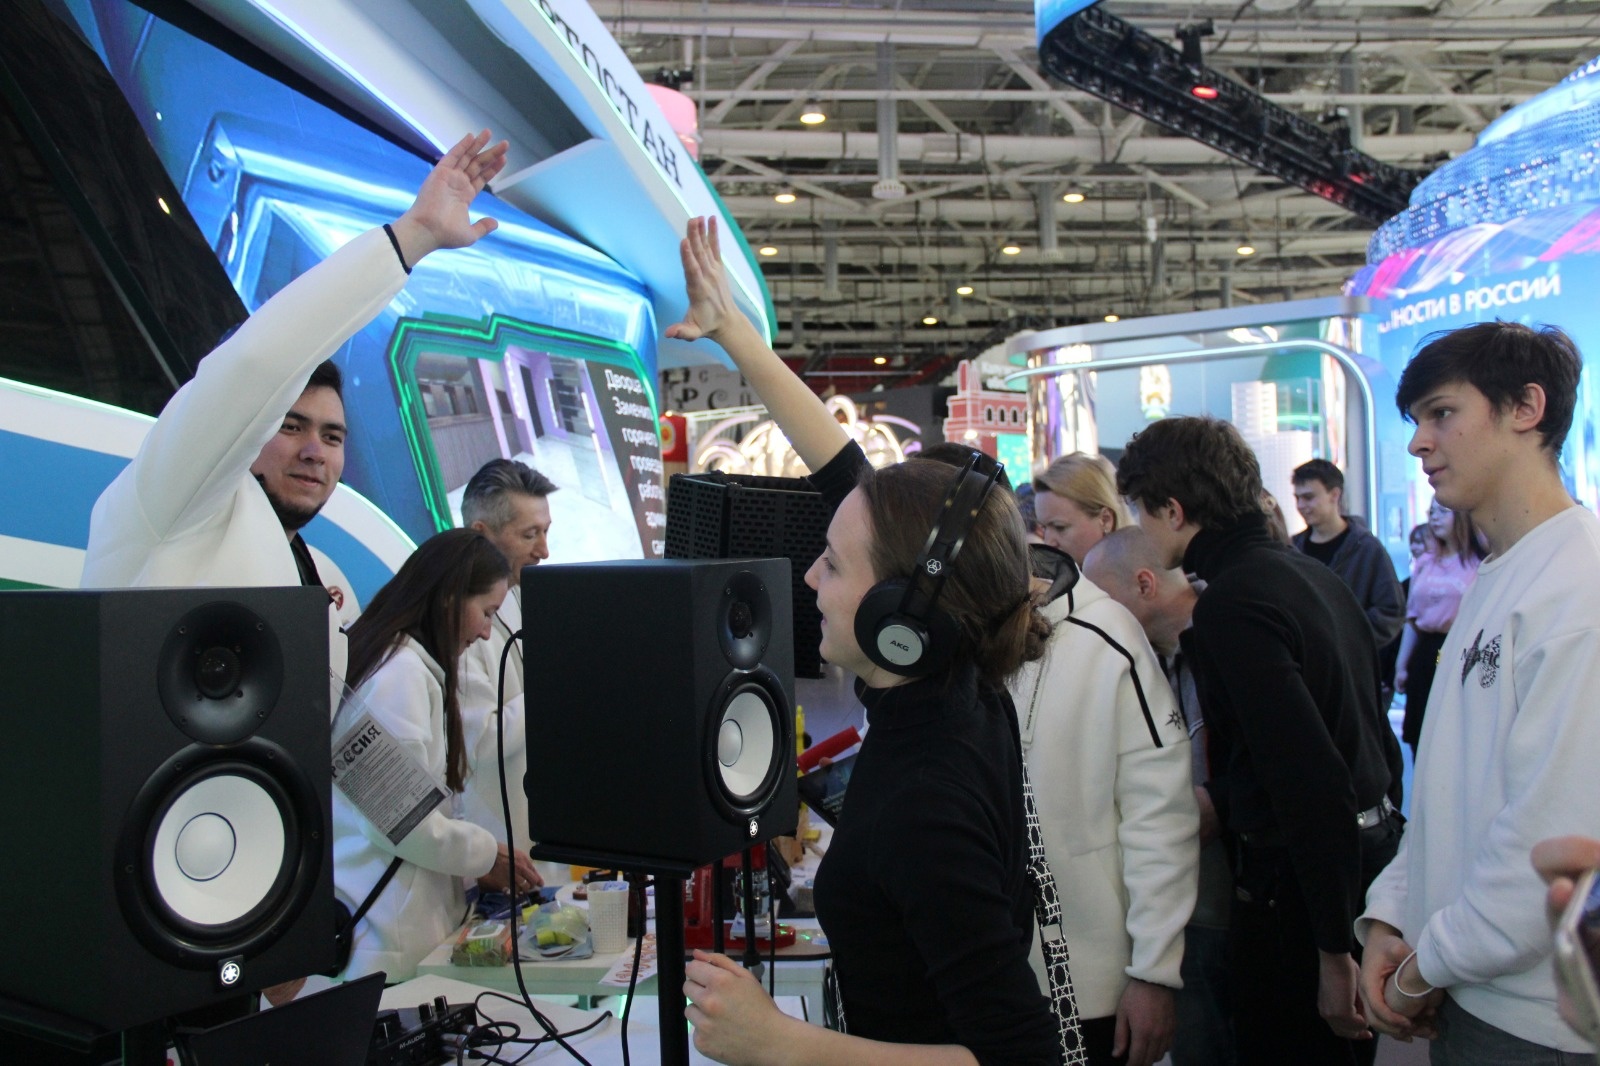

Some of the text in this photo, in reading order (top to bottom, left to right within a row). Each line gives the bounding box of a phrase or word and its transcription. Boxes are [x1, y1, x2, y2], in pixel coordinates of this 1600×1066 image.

[1449, 293, 1461, 315] В
[1464, 273, 1561, 312] РОССИИ
[889, 640, 910, 652] AKG
[399, 1032, 426, 1050] M-AUDIO
